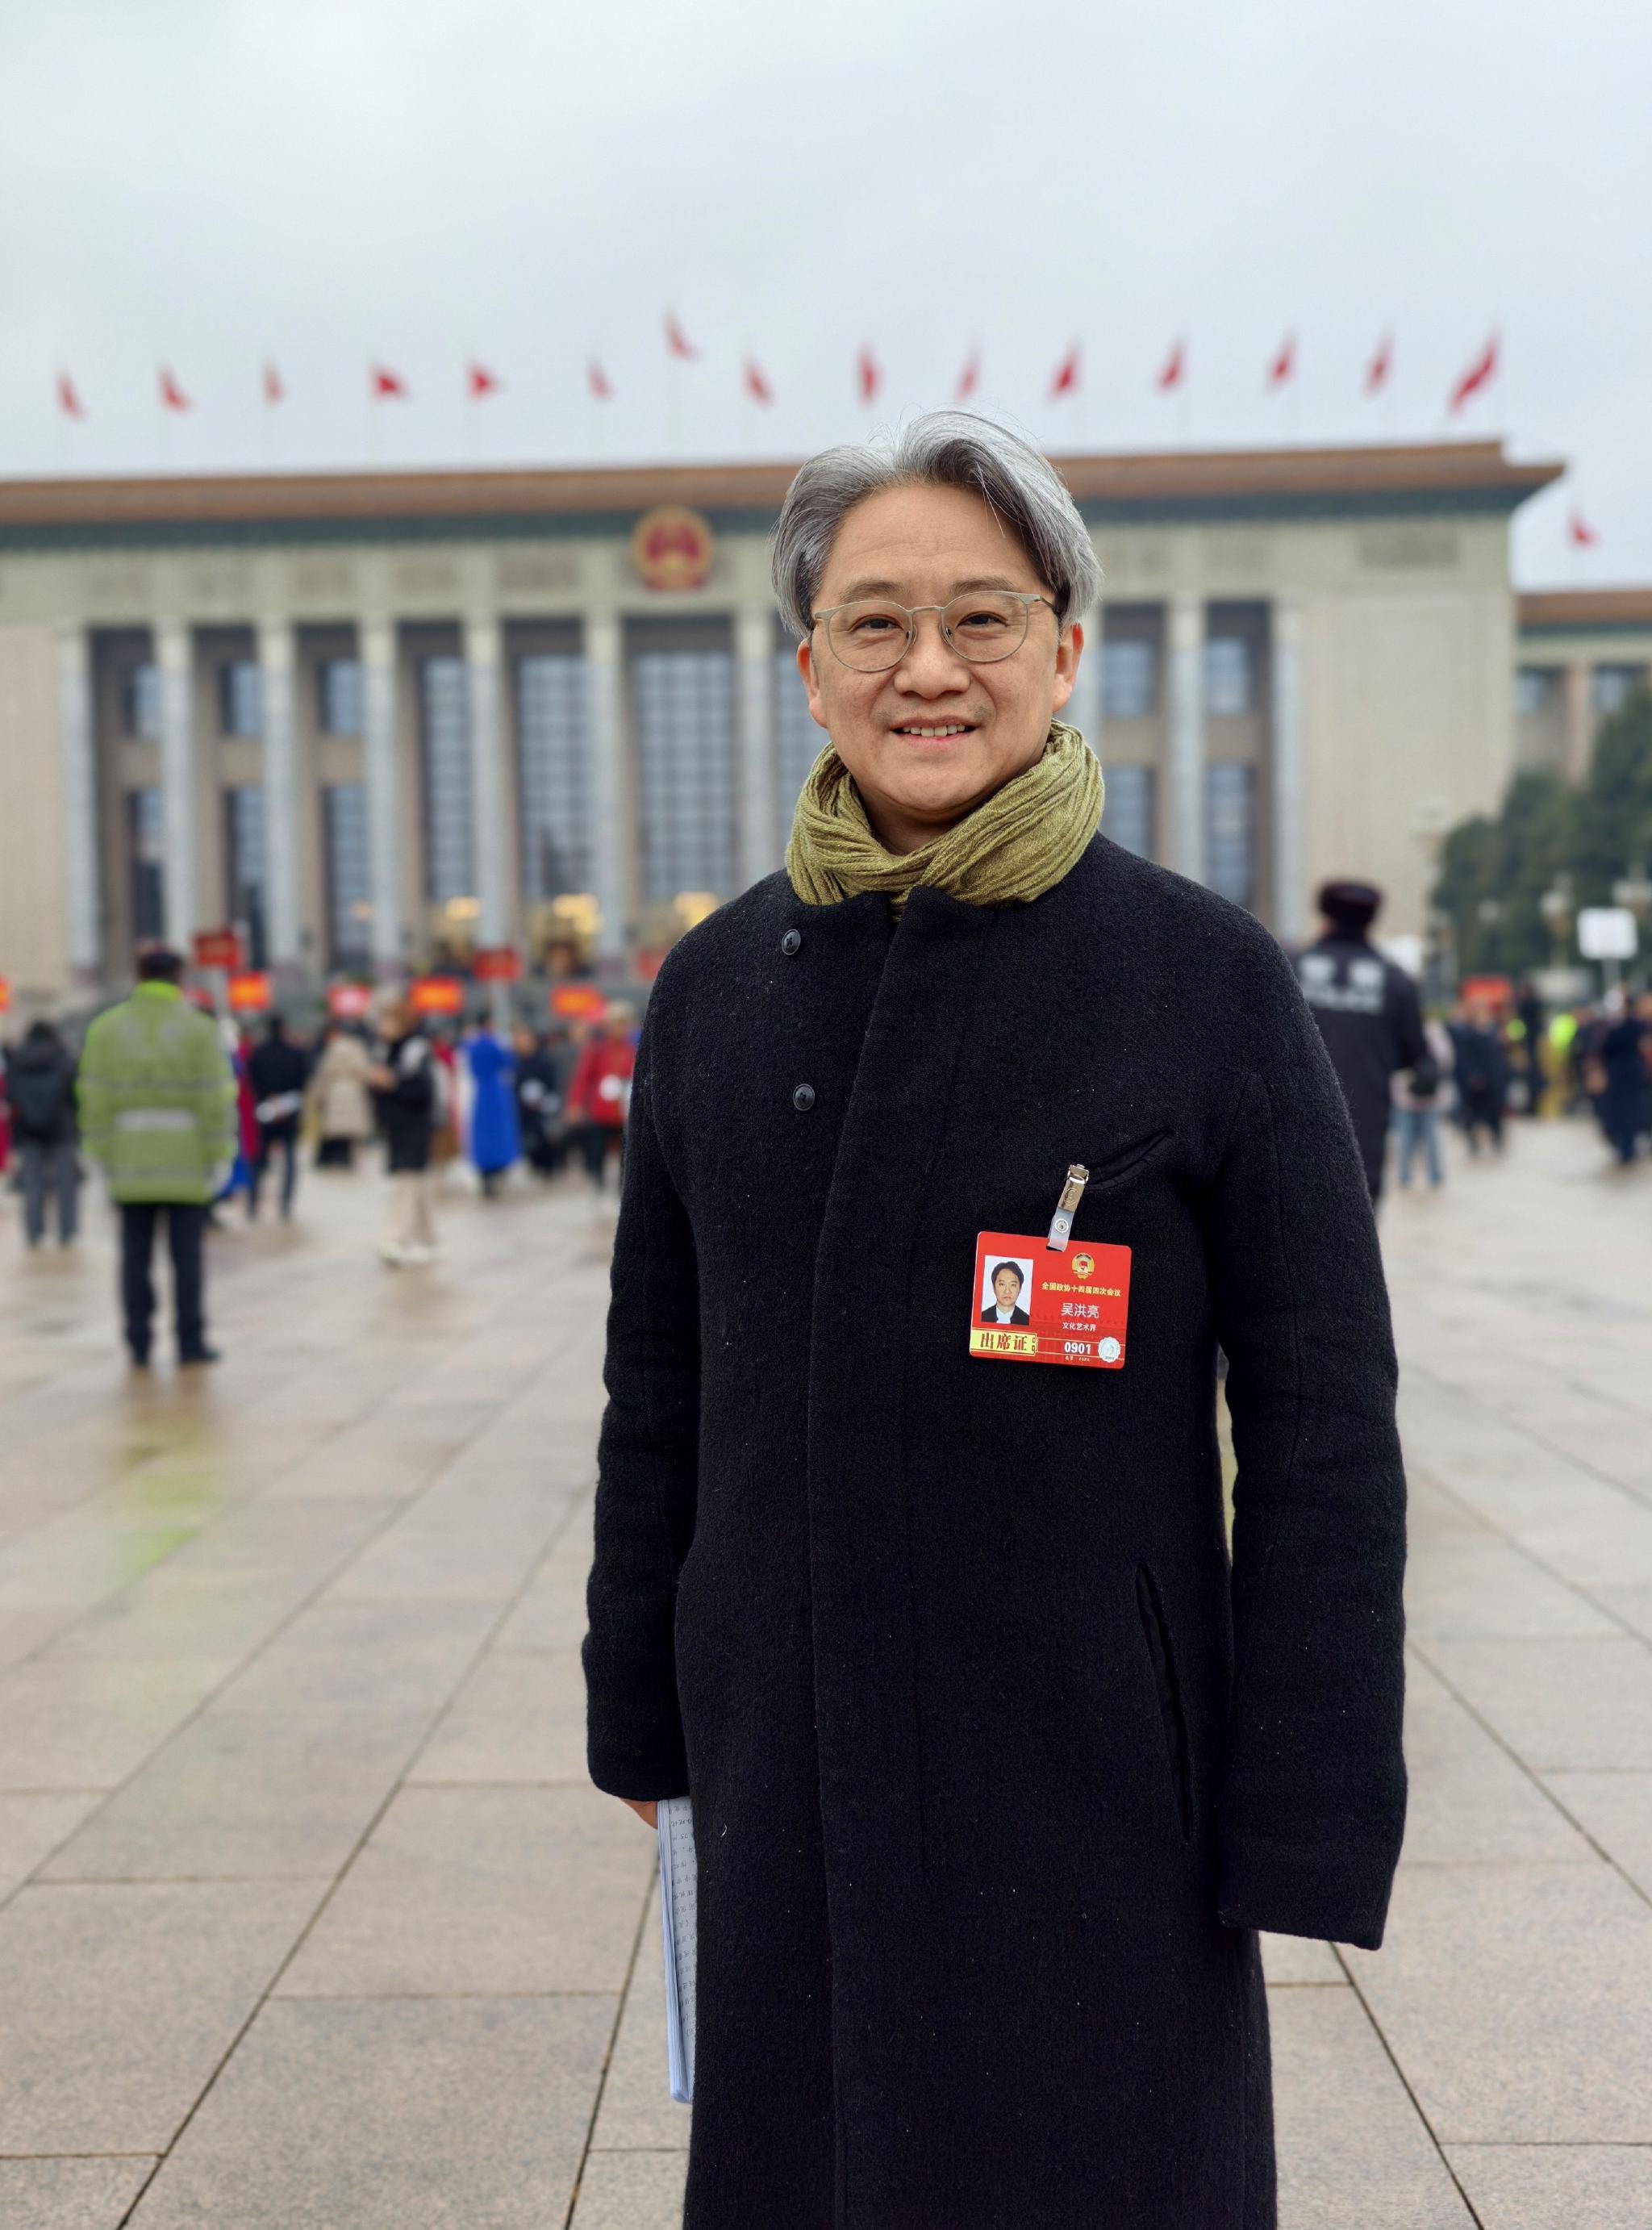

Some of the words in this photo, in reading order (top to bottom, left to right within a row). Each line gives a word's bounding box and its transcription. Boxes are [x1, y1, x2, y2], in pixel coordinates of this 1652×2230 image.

[1041, 1281, 1121, 1297] 全国政协十四届四次会议
[1061, 1302, 1099, 1319] 吴洪亮
[1062, 1322, 1096, 1332] 文化艺术界
[980, 1332, 1028, 1351] 出席证
[1064, 1341, 1091, 1355] 0901
